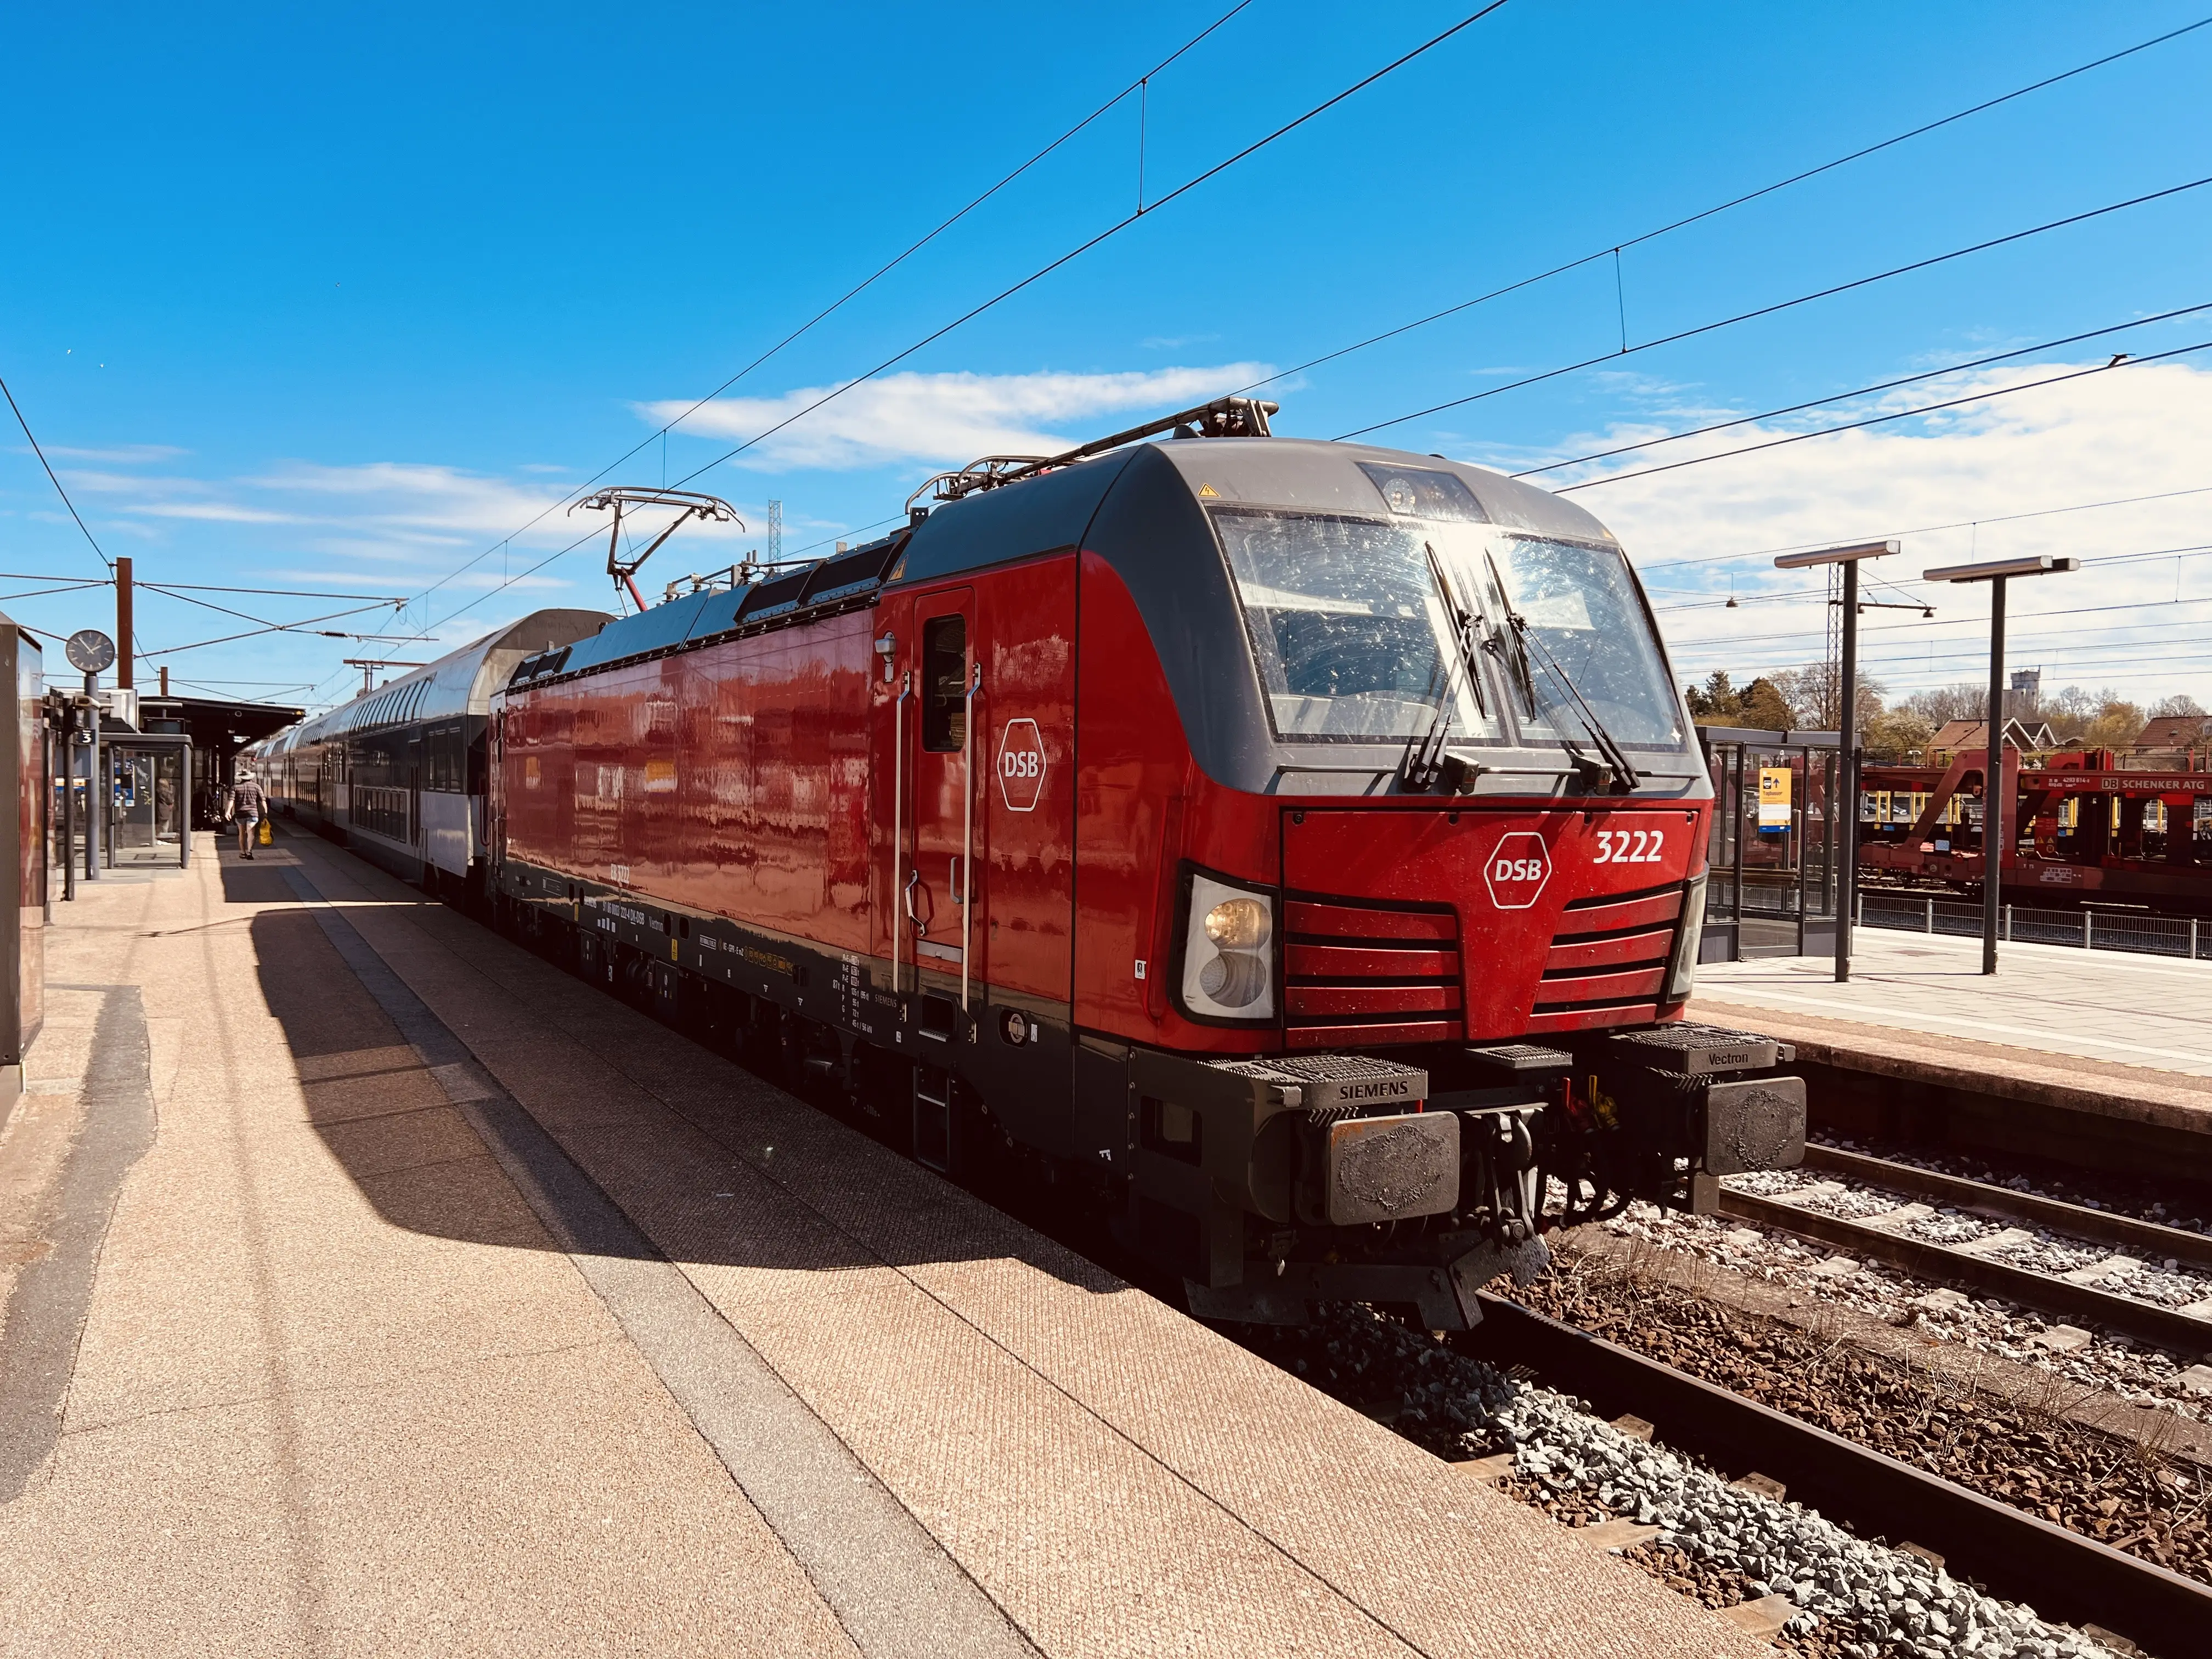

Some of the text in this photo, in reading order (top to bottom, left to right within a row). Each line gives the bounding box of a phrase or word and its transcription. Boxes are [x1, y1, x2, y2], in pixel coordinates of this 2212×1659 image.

[82, 733, 92, 743] 3
[1005, 751, 1039, 777] DSB
[2103, 779, 2205, 789] DB SCHENKER ATG
[1593, 830, 1664, 864] 3222
[611, 863, 630, 884] EB 3222
[1494, 859, 1542, 882] DSB
[874, 994, 897, 1008] SIEMENS
[1708, 1053, 1748, 1065] Vectron
[1340, 1081, 1408, 1100] SIEMENS
